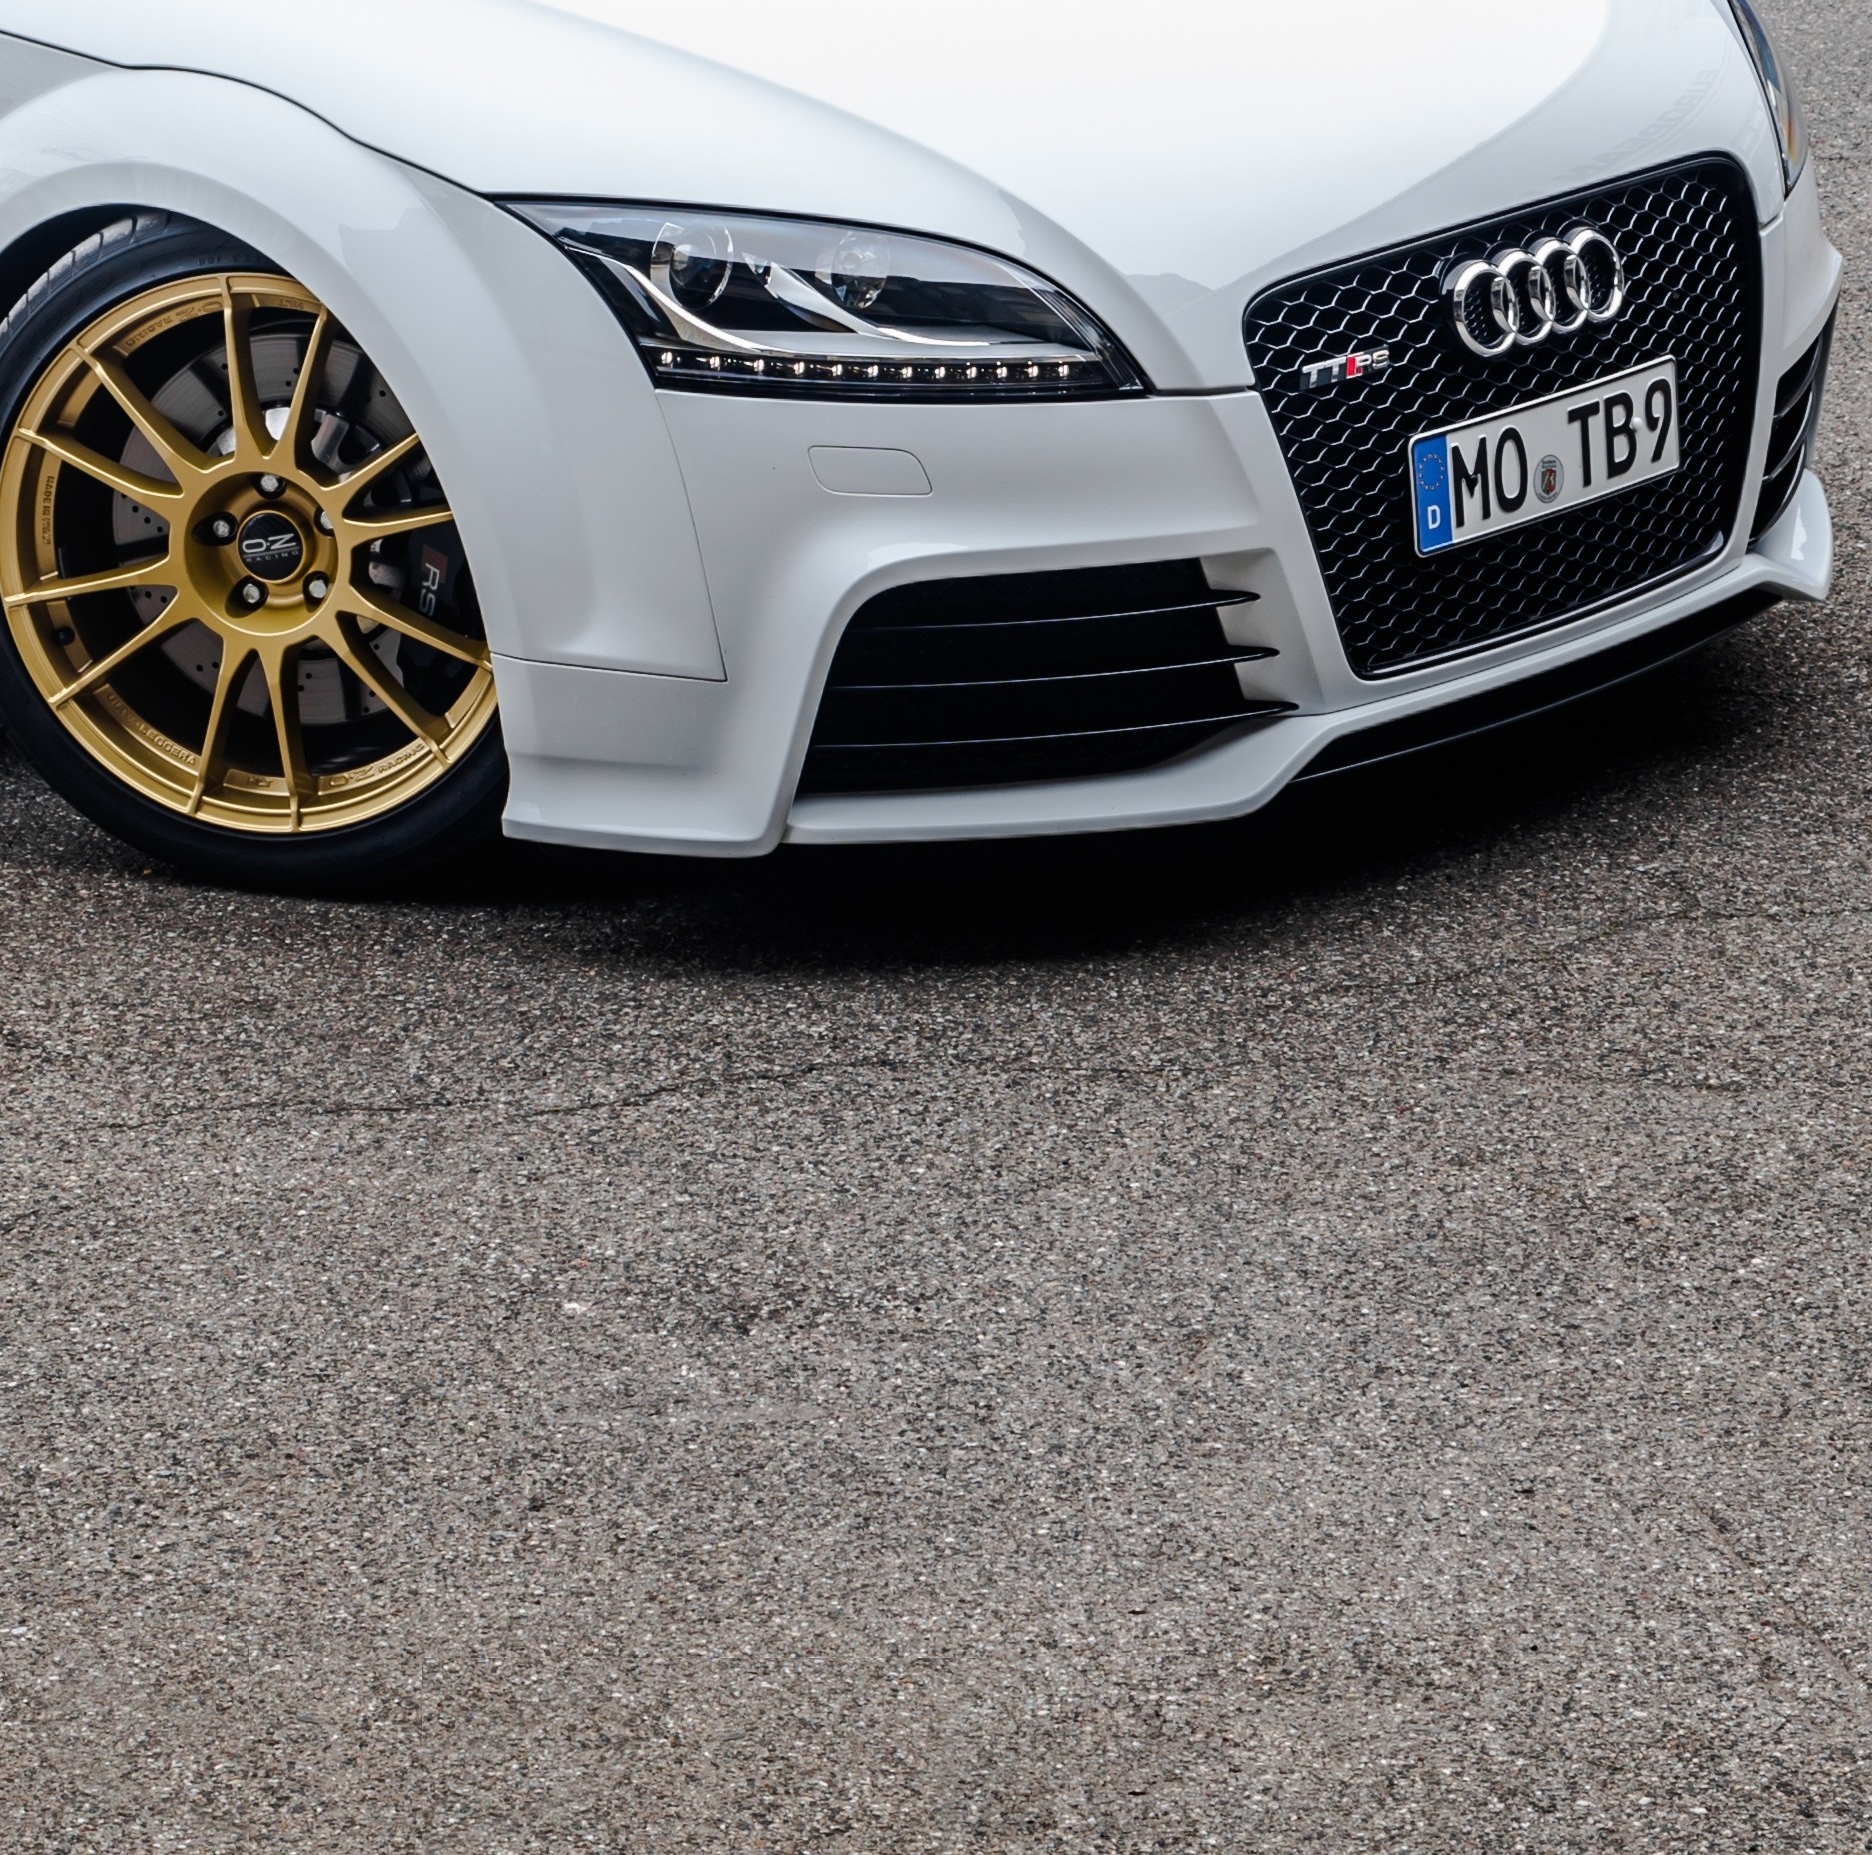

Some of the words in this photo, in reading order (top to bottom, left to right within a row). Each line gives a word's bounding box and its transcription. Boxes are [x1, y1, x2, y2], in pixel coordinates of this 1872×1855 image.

[1450, 424, 1529, 528] MO
[1427, 504, 1442, 530] D
[419, 562, 440, 617] RS
